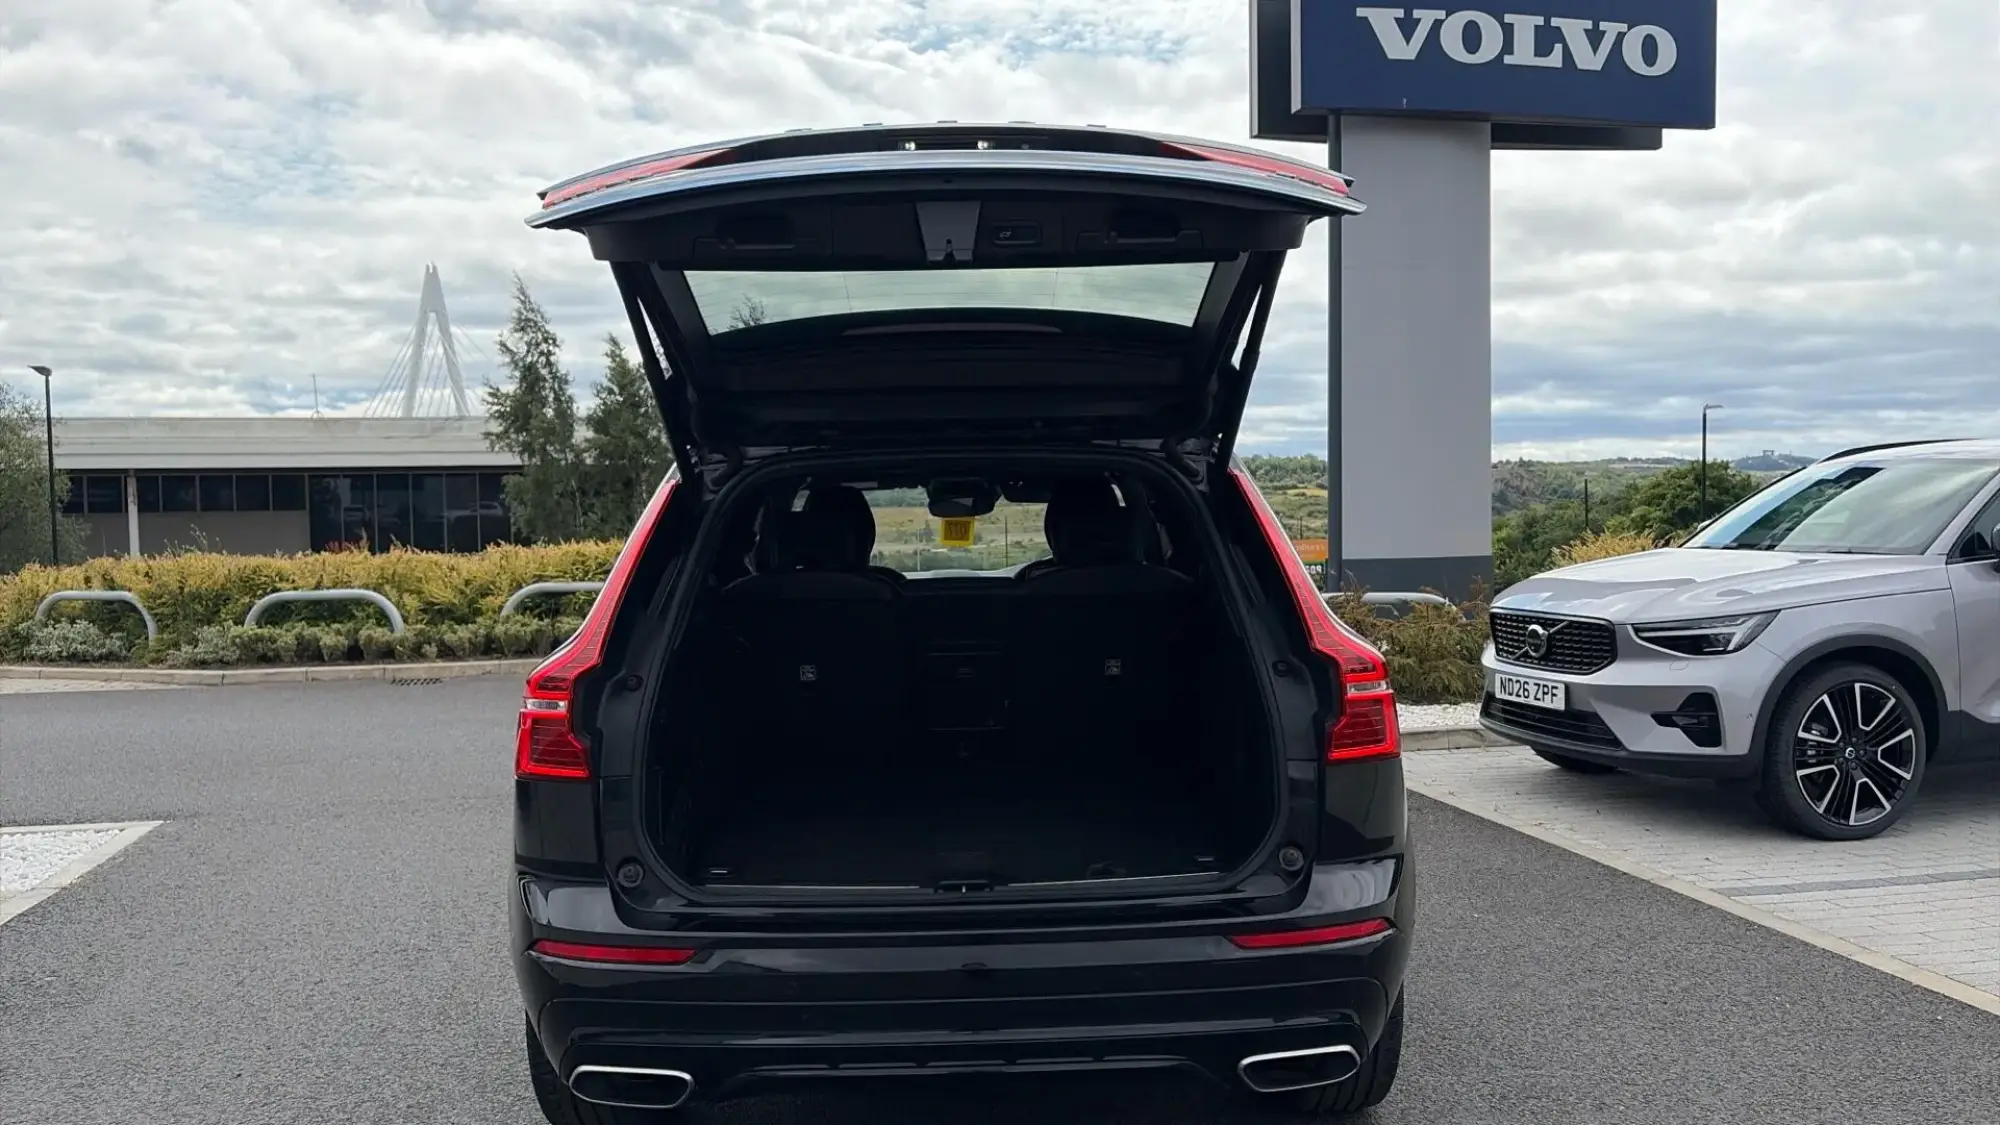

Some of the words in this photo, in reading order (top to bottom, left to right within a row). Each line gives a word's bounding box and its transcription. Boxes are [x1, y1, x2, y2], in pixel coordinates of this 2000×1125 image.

[1356, 7, 1677, 76] VOLVO
[1500, 676, 1530, 699] ND26
[1533, 682, 1558, 704] ZPF
